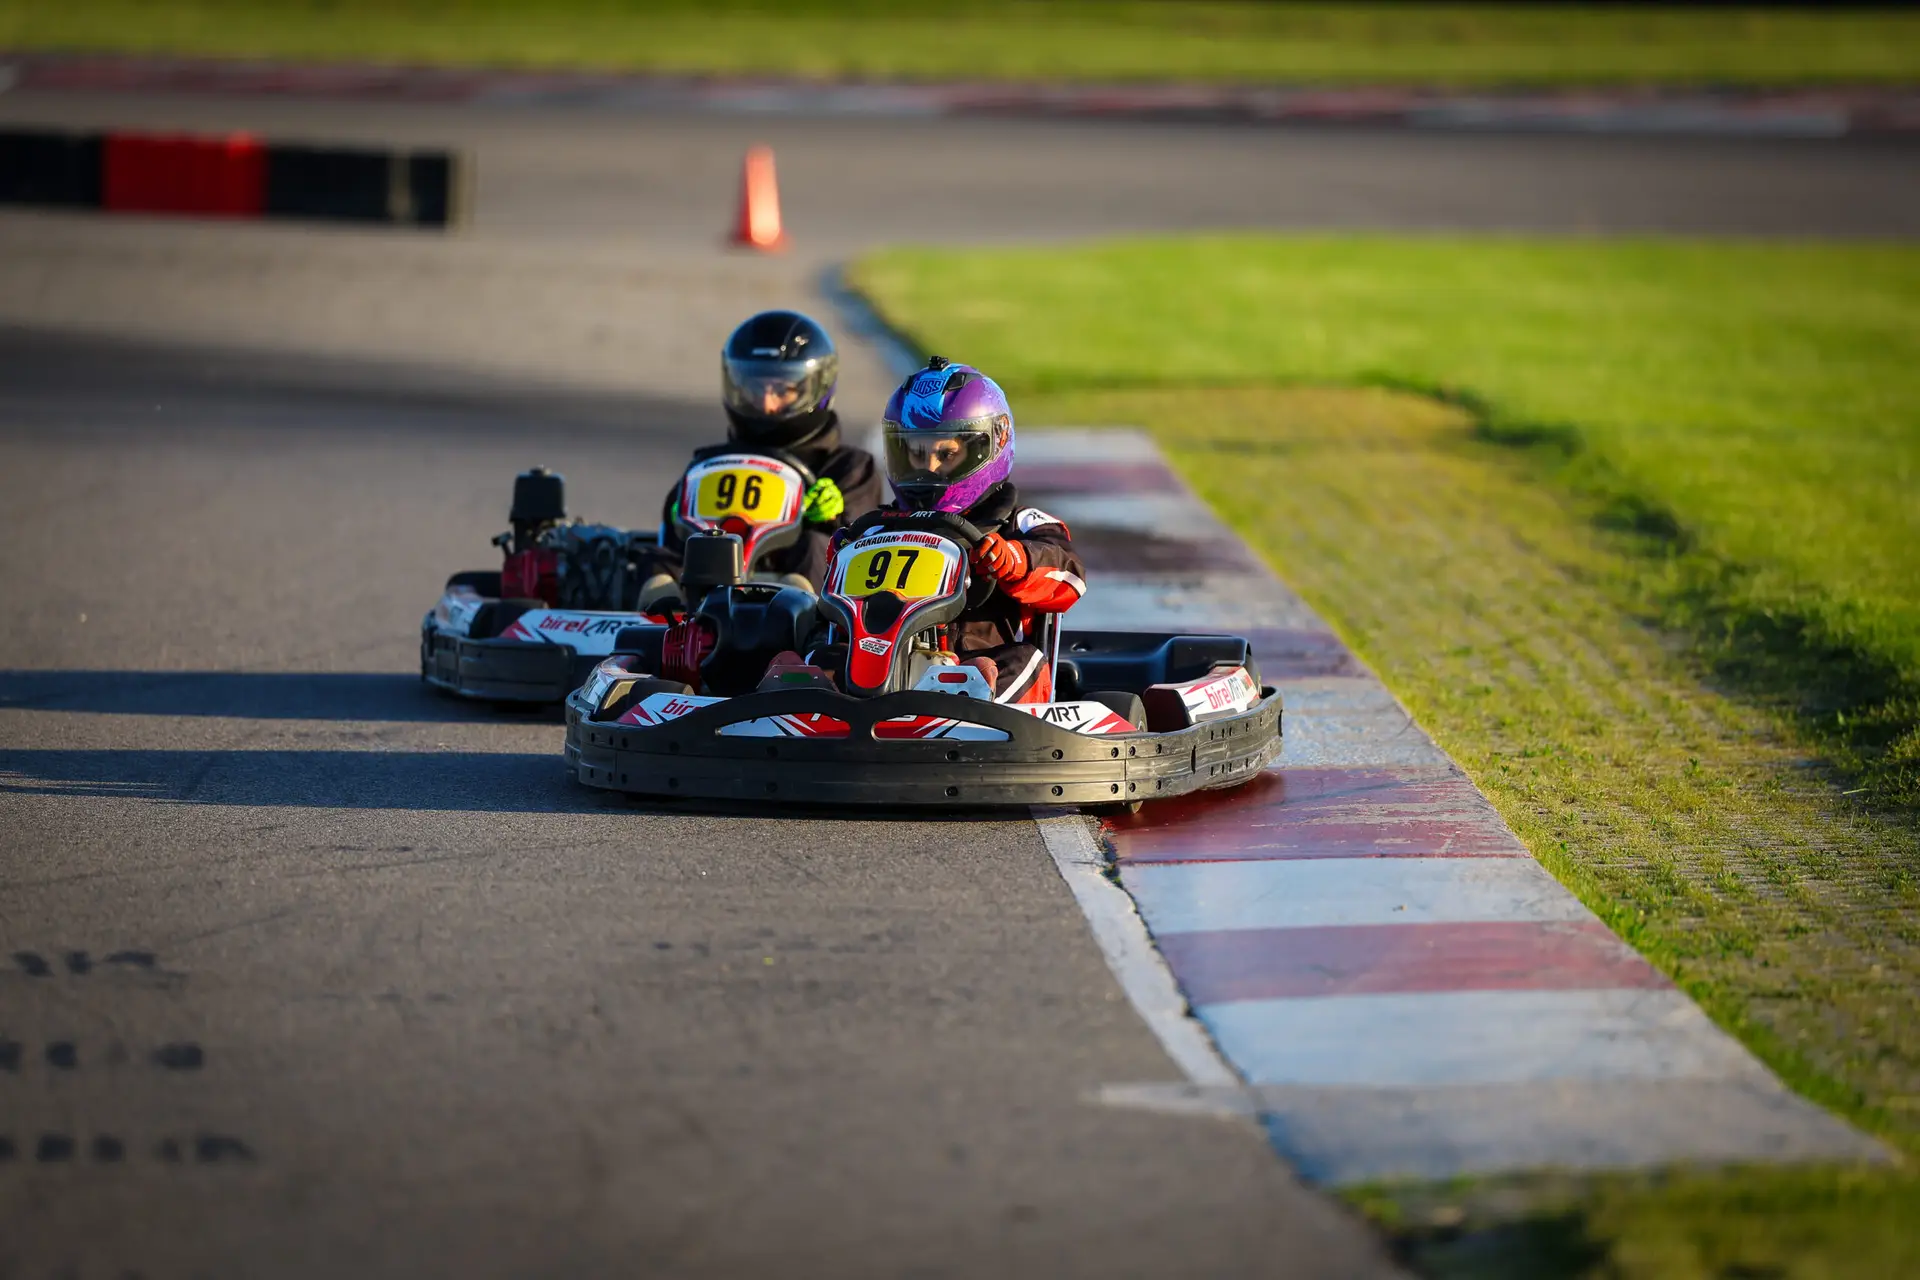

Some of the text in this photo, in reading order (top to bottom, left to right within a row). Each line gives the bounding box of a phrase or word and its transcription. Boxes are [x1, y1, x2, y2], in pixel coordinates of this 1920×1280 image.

[715, 474, 763, 510] 96
[854, 535, 897, 549] CANADIAN
[865, 550, 919, 589] 97
